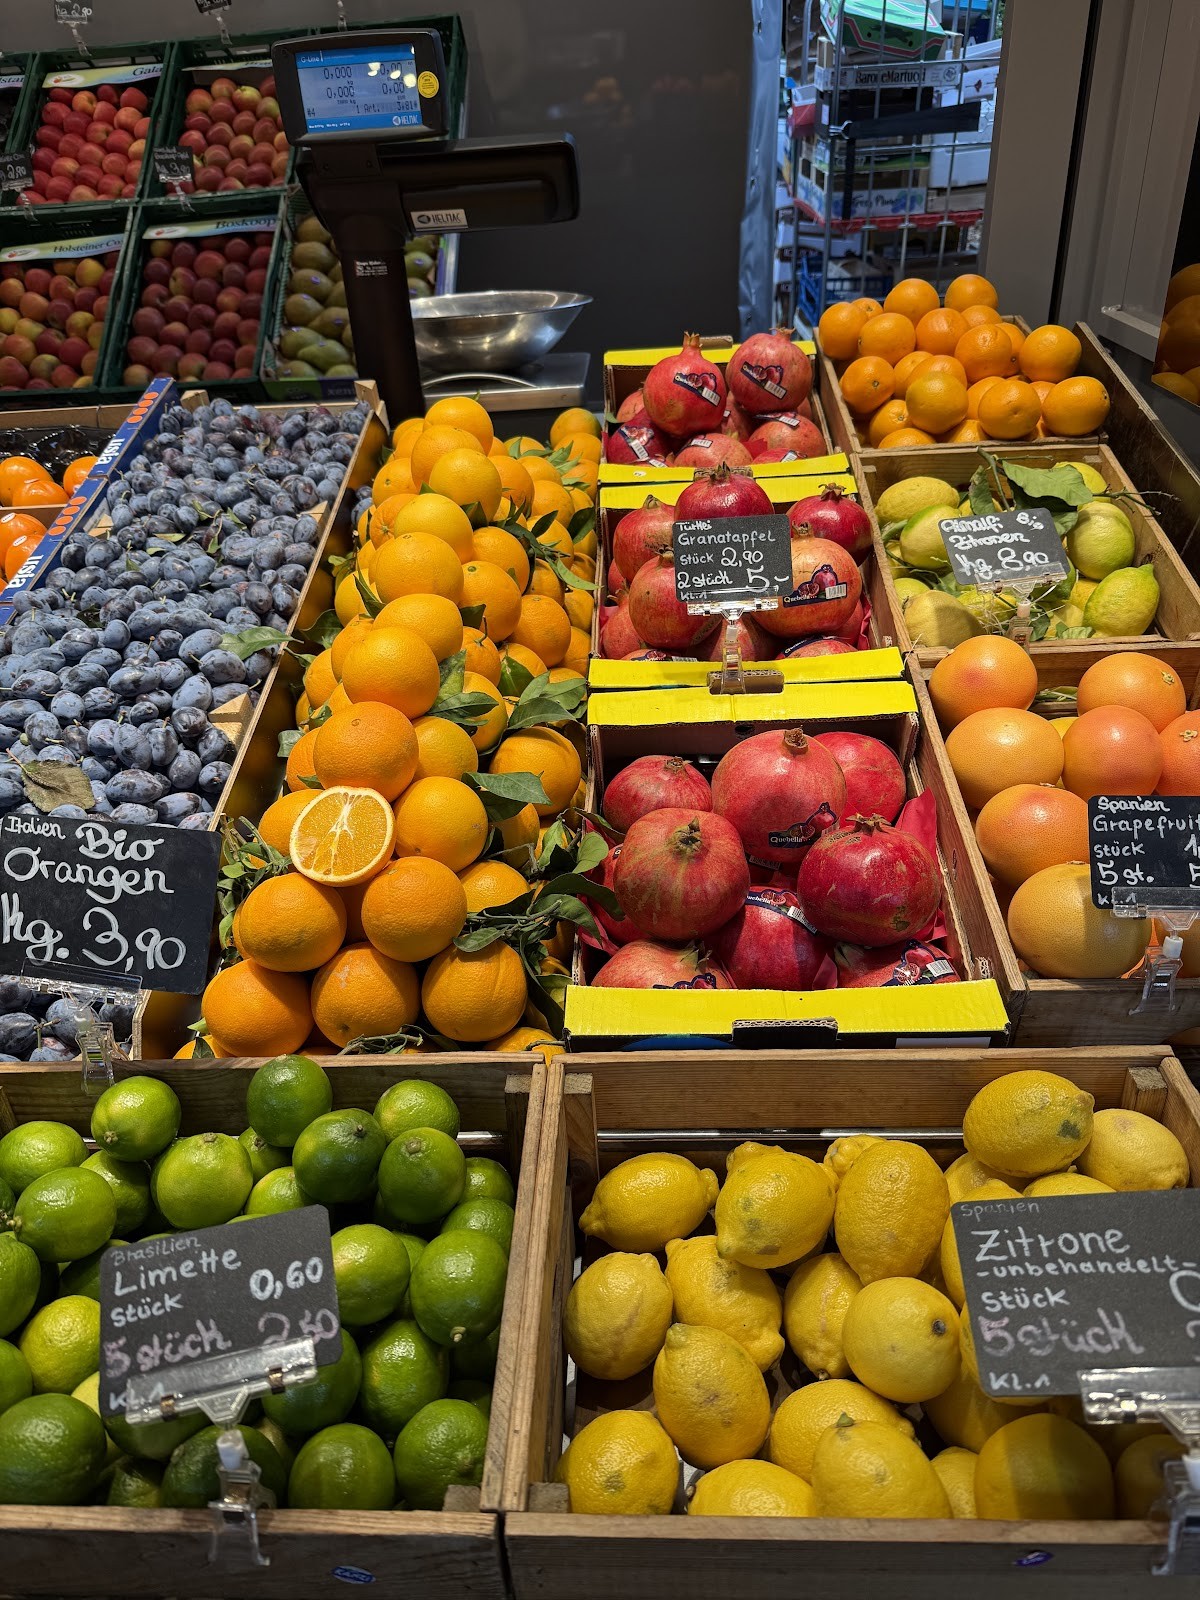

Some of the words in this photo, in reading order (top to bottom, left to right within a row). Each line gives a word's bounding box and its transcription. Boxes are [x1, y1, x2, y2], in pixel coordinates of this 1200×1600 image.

[323, 66, 352, 80] 0,000
[326, 86, 355, 99] 0,000
[382, 82, 405, 94] 0,00
[216, 218, 277, 229] Boskoop
[53, 242, 105, 253] Holsteiner
[1015, 512, 1045, 531] Bio
[677, 530, 776, 550] Granatapfel
[948, 532, 1031, 551] Zitronen
[720, 547, 764, 567] 2,90
[997, 547, 1050, 571] 8,90
[1097, 795, 1171, 814] Spanien
[75, 822, 165, 861] Bio
[4, 846, 175, 905] Orangen
[1096, 859, 1119, 886] 5
[746, 895, 771, 904] uebella
[82, 906, 187, 972] 3,90
[960, 1200, 1041, 1223] Spanien
[110, 1236, 202, 1267] Brasilien
[970, 1226, 1131, 1263] Zitrone
[113, 1248, 242, 1298] Limette
[248, 1256, 324, 1301] 0,60
[103, 1335, 132, 1379] 5
